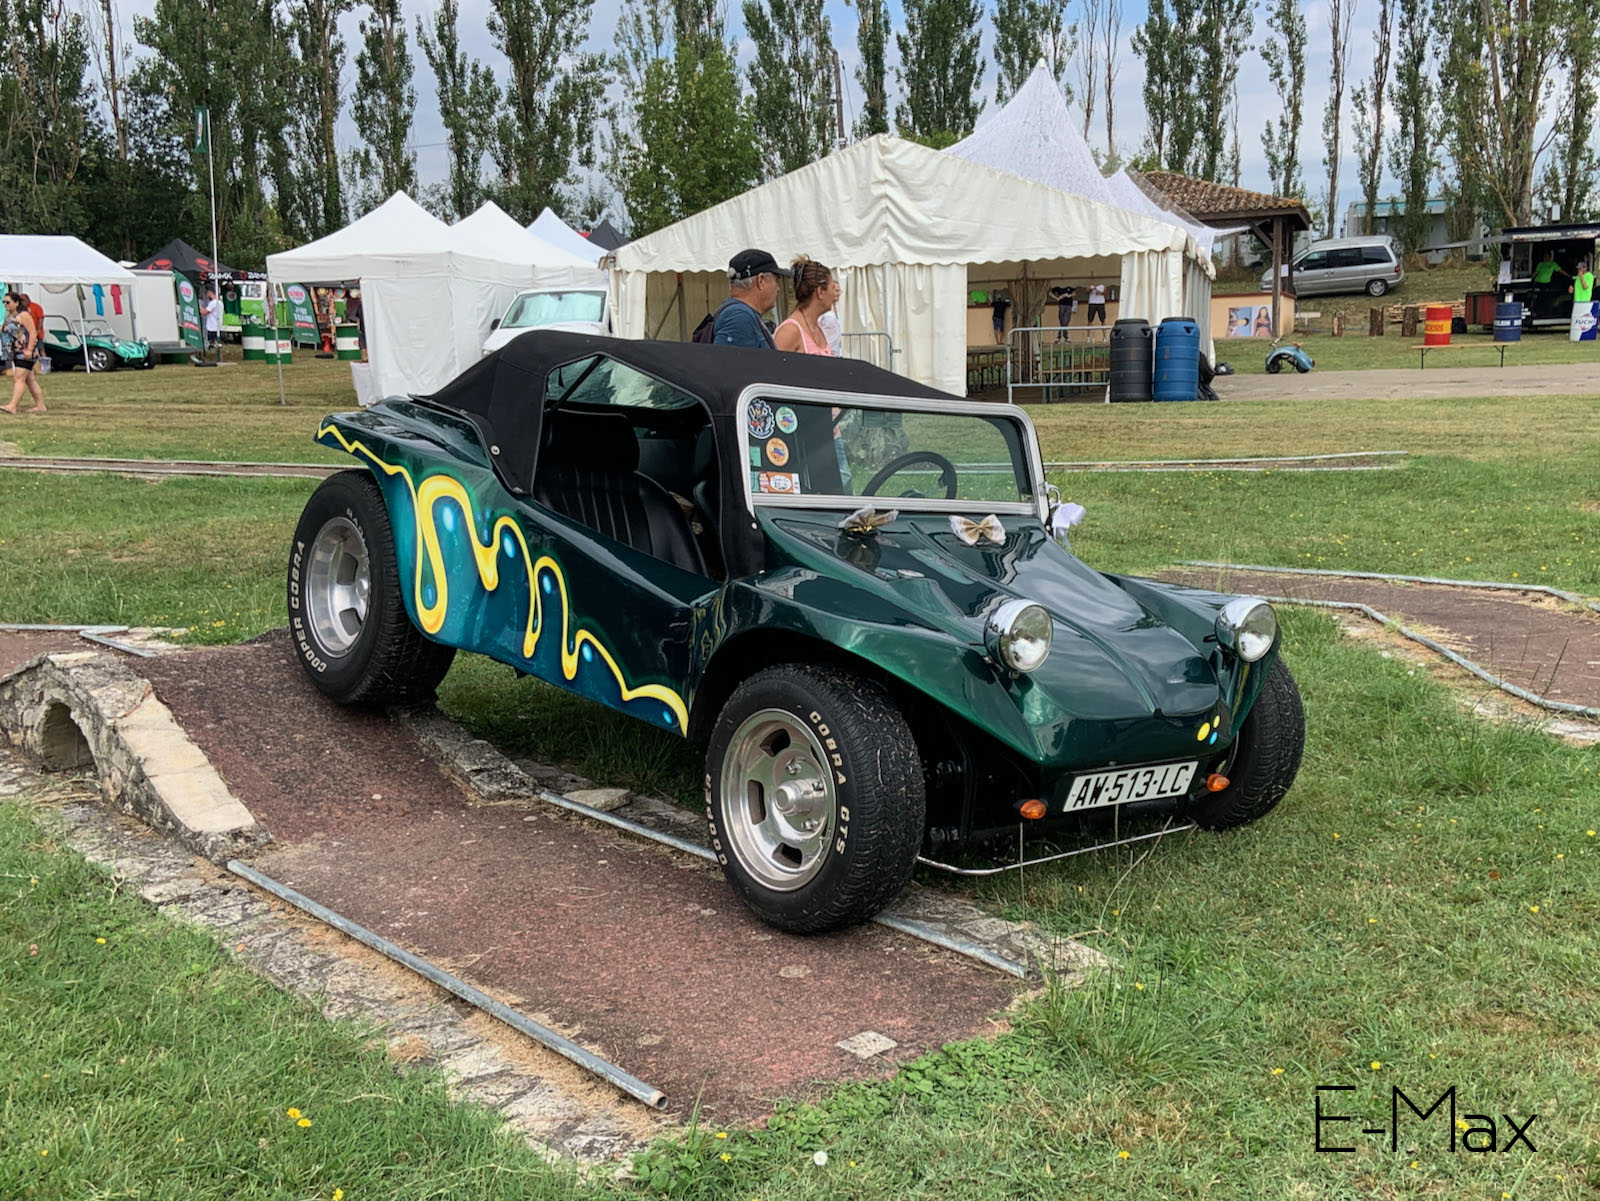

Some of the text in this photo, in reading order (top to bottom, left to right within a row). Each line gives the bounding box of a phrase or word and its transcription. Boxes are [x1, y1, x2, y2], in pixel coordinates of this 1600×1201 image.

[290, 540, 328, 673] COOPER COBRA
[809, 711, 851, 855] COBRA GTS
[1072, 765, 1190, 808] AW-513-LC
